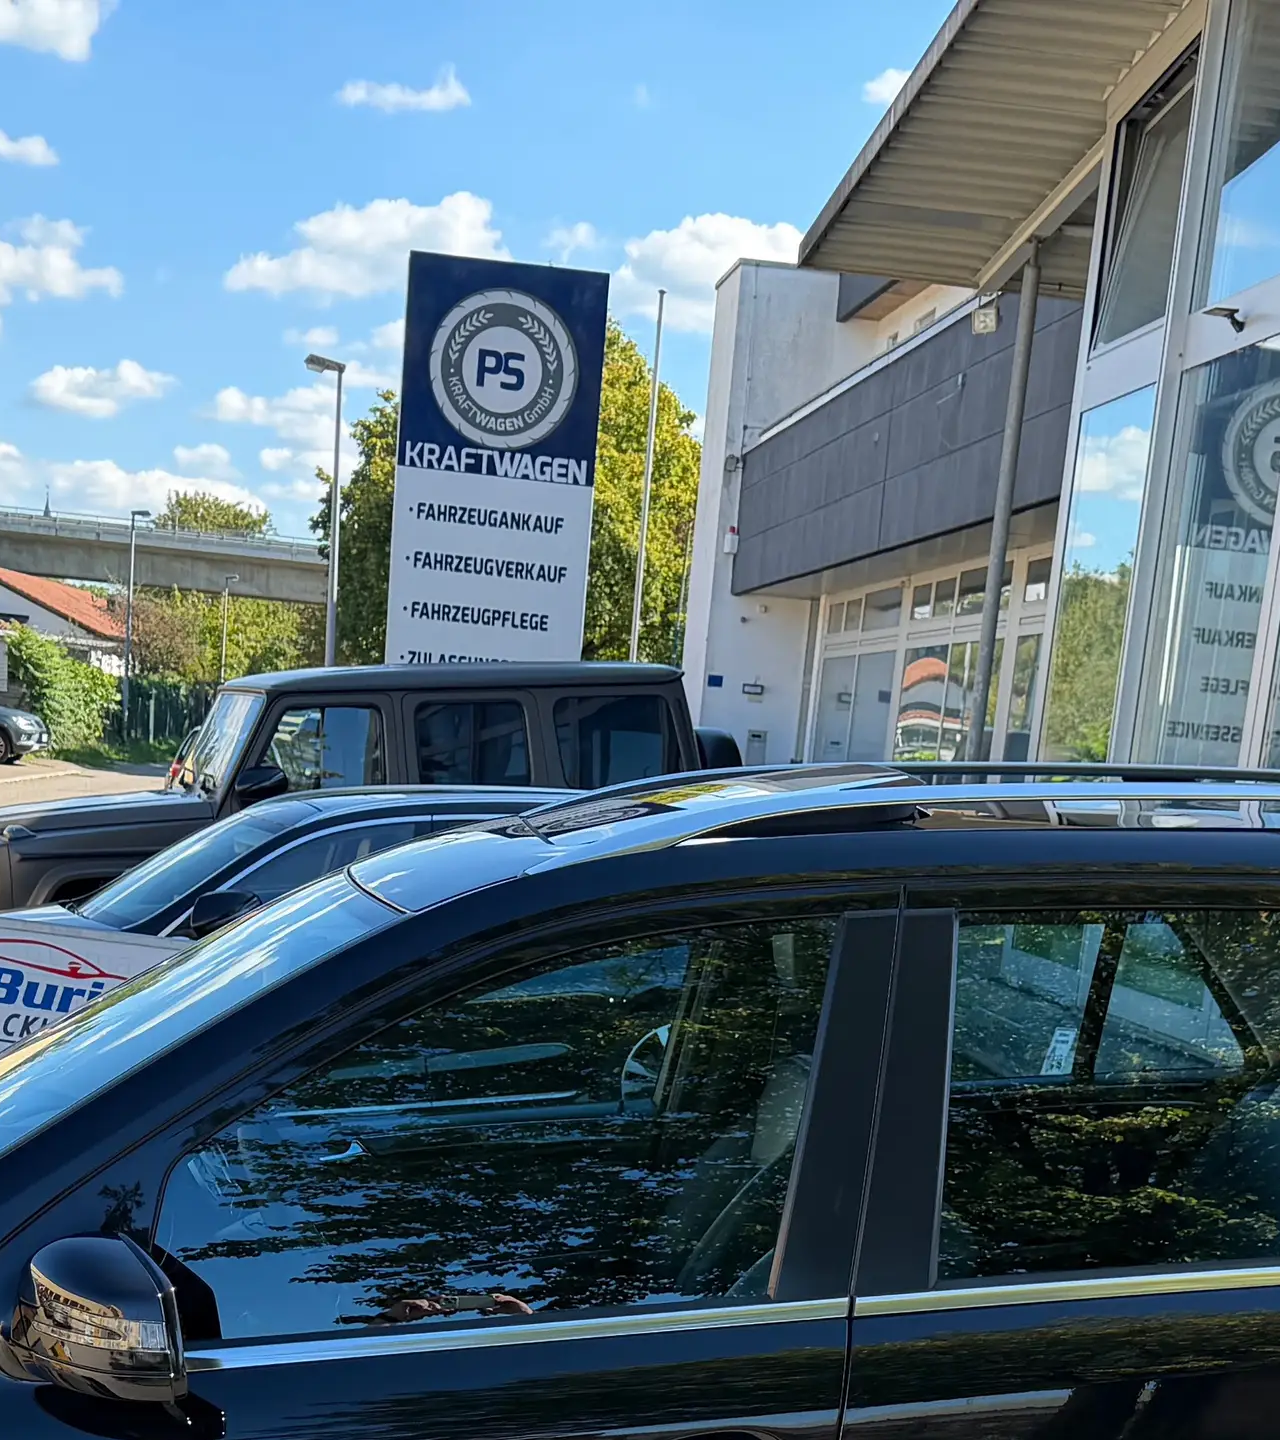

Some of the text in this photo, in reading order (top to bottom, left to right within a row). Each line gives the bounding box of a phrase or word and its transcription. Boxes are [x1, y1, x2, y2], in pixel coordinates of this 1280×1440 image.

[475, 347, 526, 392] PS
[448, 376, 555, 431] KRAFTWAGEN GmbH
[404, 440, 588, 486] KRAFTWAGEN
[416, 501, 565, 535] FAHRZEUGANKAUF
[413, 550, 568, 584] FAHRZEUGVERKAUF
[410, 600, 549, 632] FAHRZEUGPFLEGE
